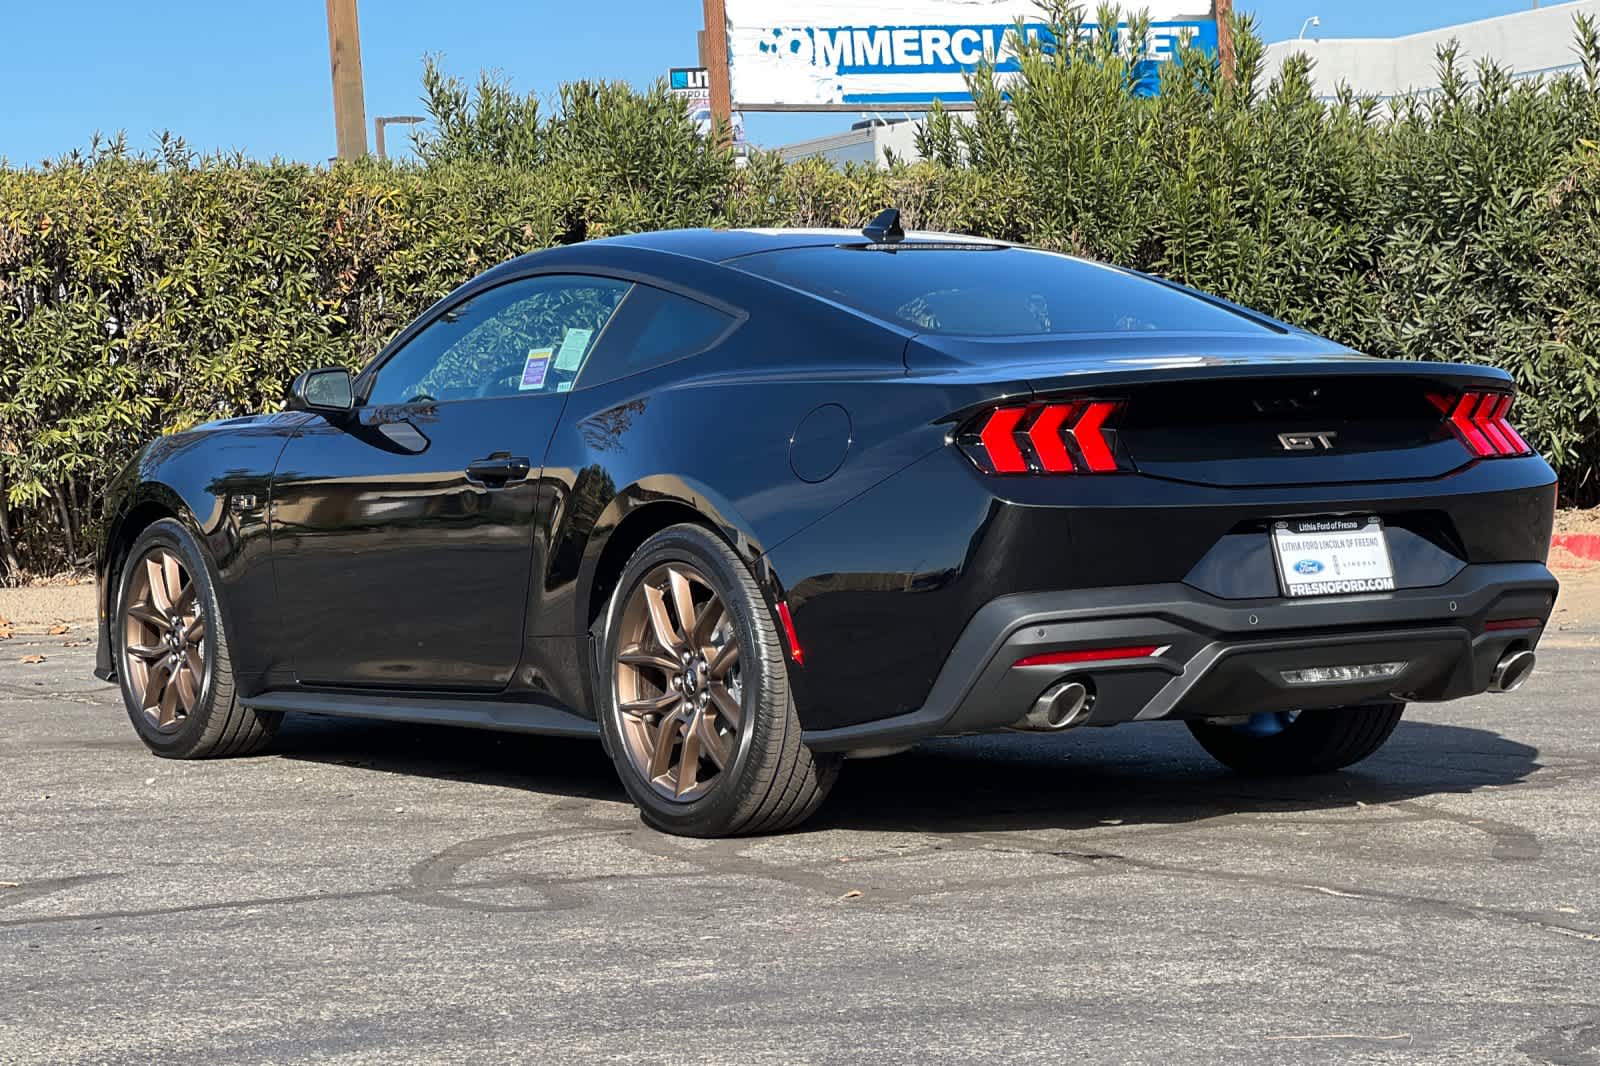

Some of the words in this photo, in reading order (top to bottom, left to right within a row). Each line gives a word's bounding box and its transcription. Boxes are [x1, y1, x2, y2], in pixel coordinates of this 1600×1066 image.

[1277, 431, 1337, 450] GT
[1299, 523, 1316, 531] Lithia
[1317, 522, 1330, 530] Ford
[1331, 521, 1338, 529] of
[1338, 521, 1358, 529] Fresno
[1281, 541, 1302, 552] LITHIA
[1302, 540, 1319, 551] FORD
[1319, 539, 1345, 550] LINCOLN
[1346, 538, 1354, 548] OF
[1354, 537, 1378, 547] FRESNO
[1289, 577, 1394, 596] FRESNOFORD.COM
